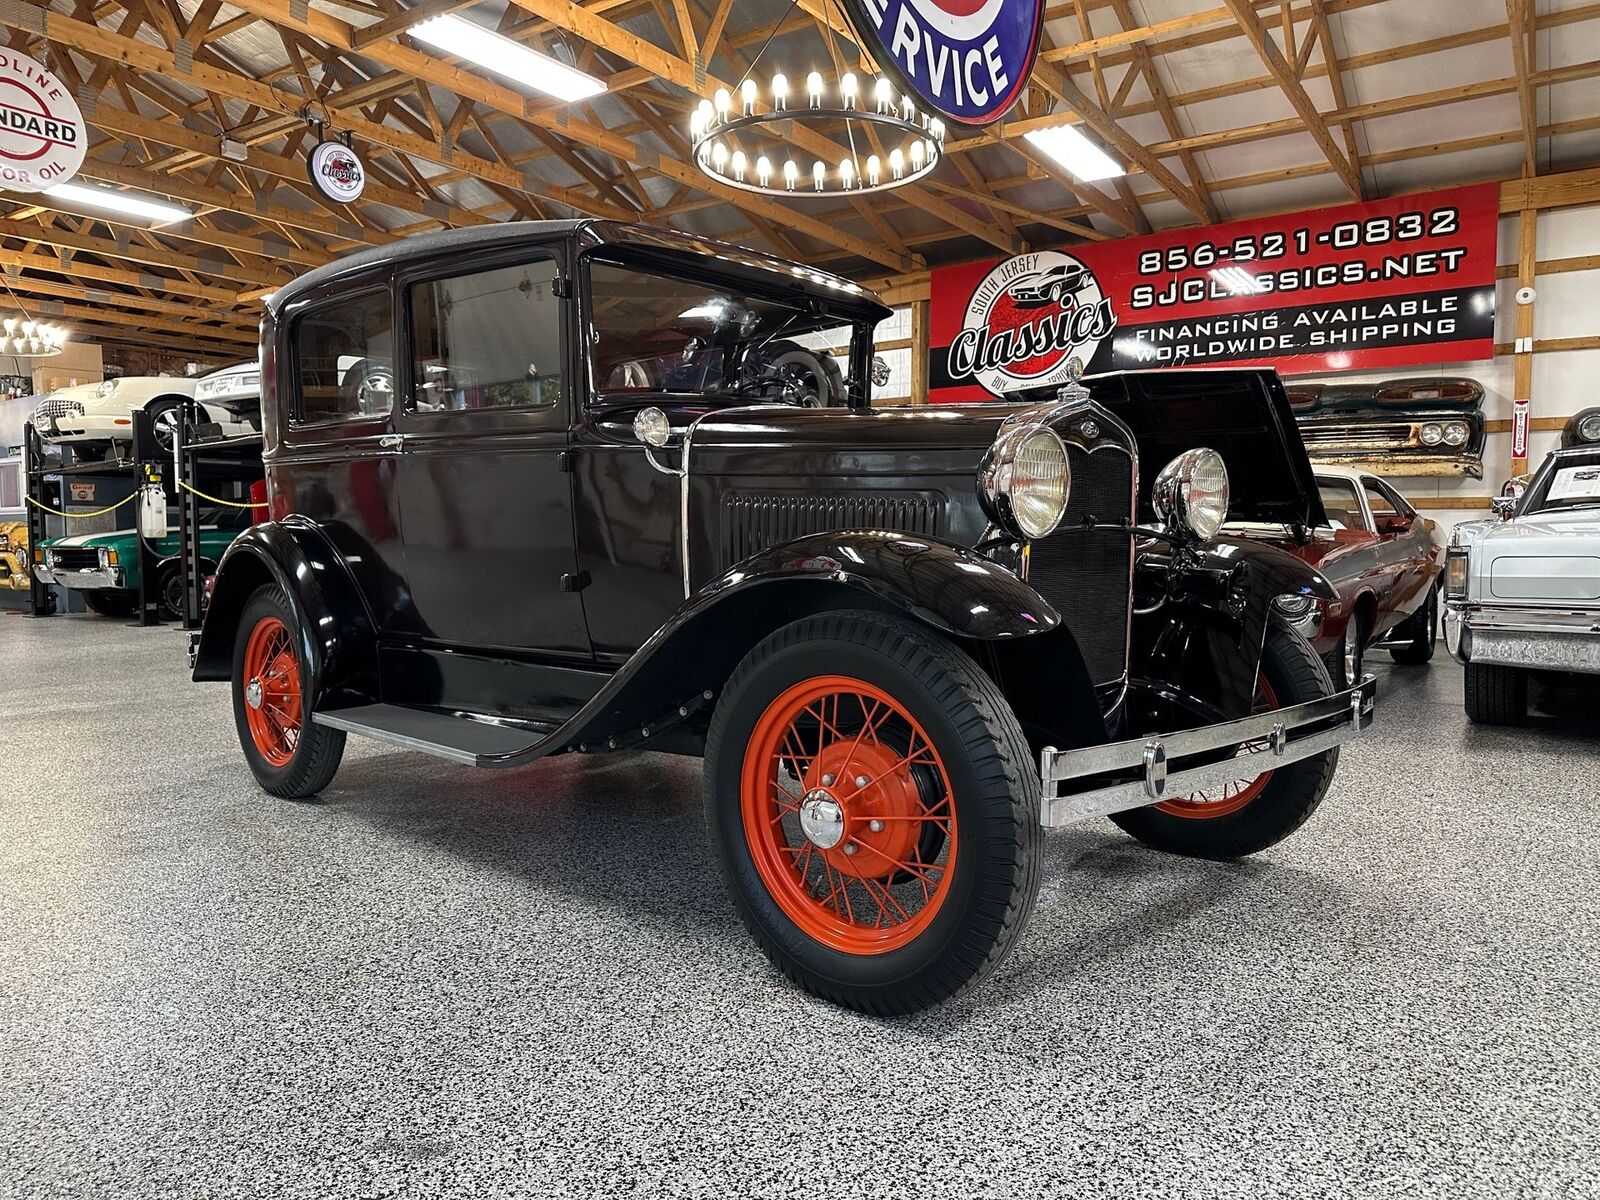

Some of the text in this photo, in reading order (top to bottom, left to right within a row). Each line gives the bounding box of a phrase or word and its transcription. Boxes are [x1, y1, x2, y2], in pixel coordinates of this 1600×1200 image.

[39, 161, 66, 180] OIL
[1140, 208, 1456, 275] 856-521-0832
[971, 254, 1039, 316] SOUTH JERSEY
[947, 297, 1117, 380] Classics
[1135, 295, 1458, 344] FINANCING AVAILABLE
[1135, 318, 1456, 363] WORLDWIDE SHIPPING
[991, 375, 1008, 390] BUY
